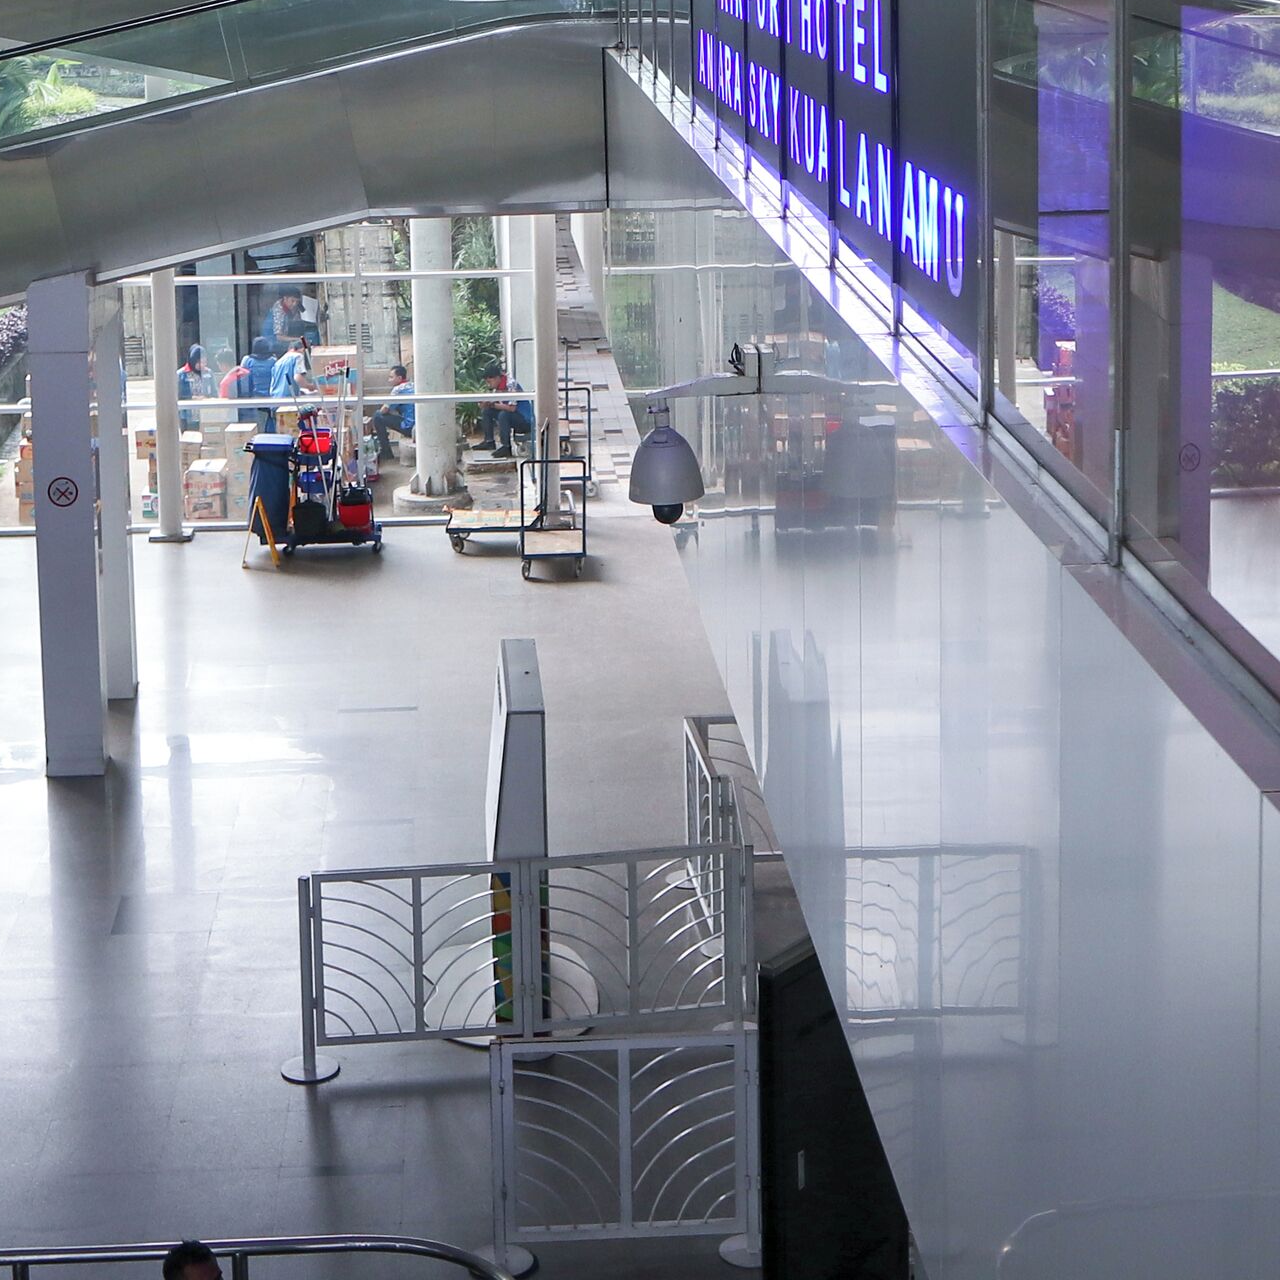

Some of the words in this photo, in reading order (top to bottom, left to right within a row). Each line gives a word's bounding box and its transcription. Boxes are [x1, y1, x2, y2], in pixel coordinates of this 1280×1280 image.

[698, 28, 743, 116] ANARA
[749, 61, 781, 145] SKY
[789, 85, 965, 298] KUALANAMU
